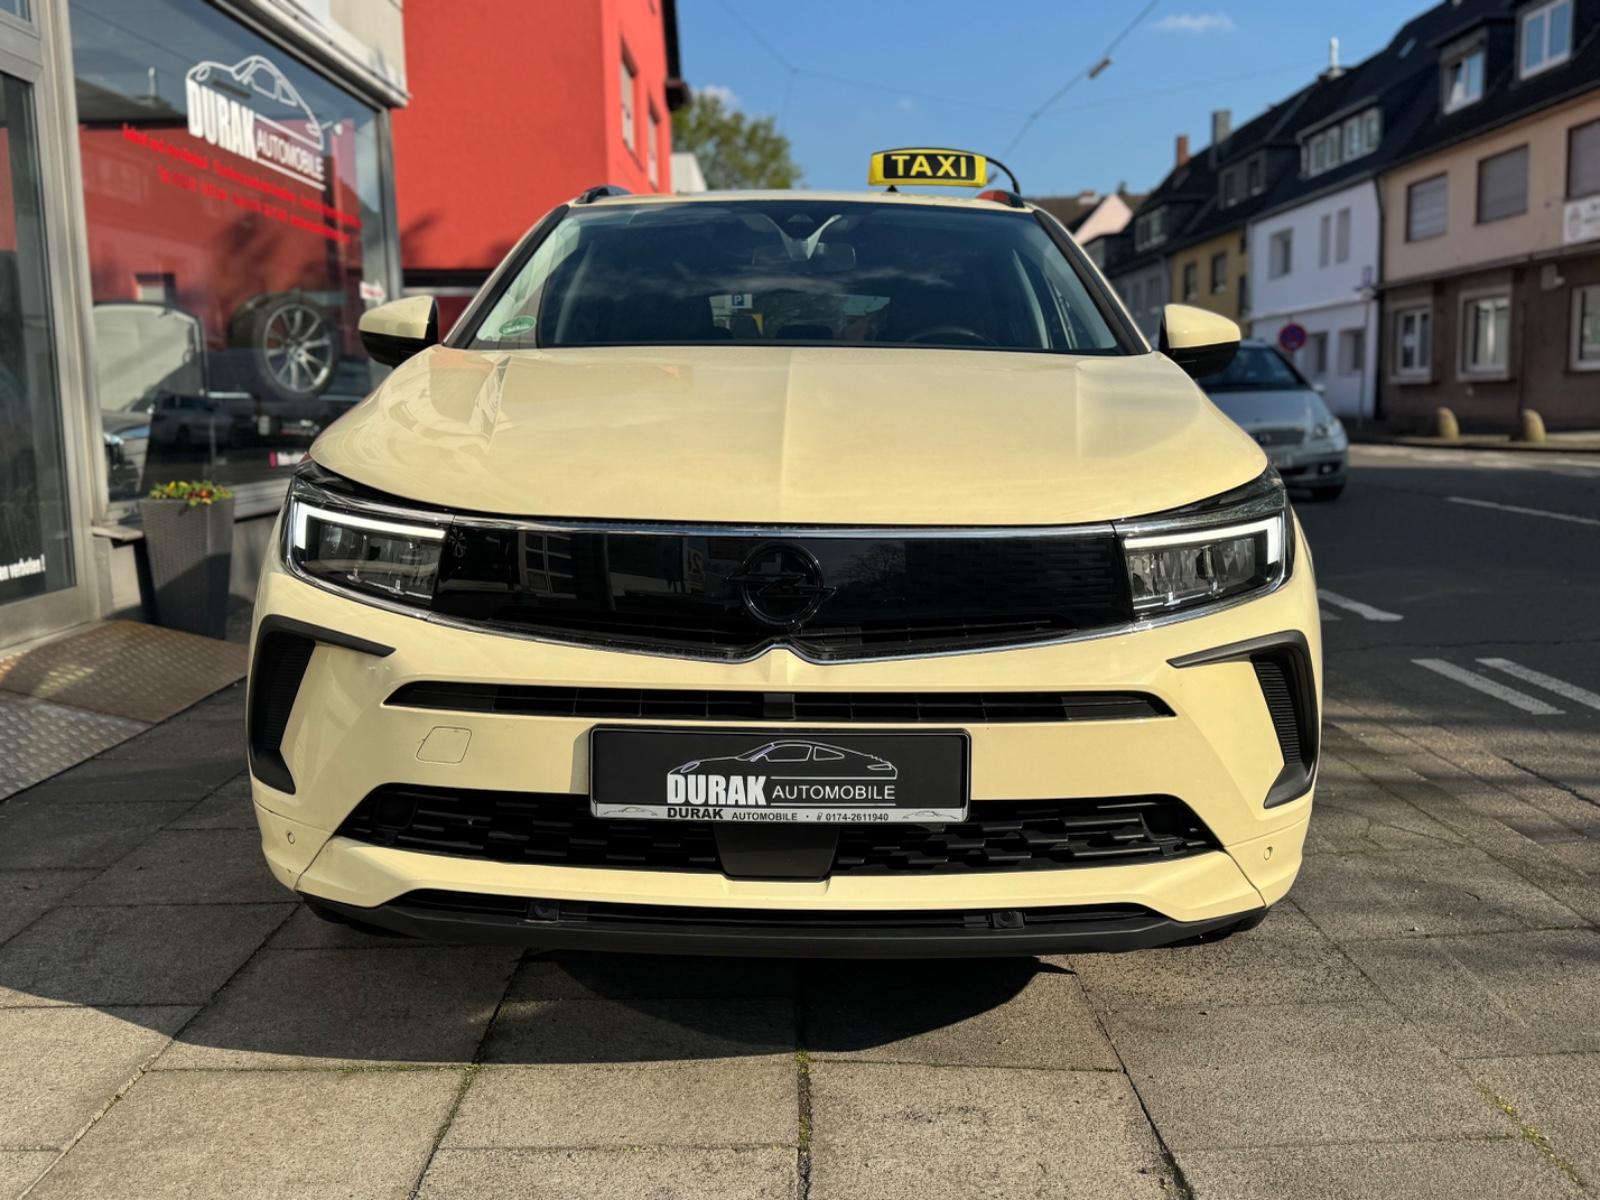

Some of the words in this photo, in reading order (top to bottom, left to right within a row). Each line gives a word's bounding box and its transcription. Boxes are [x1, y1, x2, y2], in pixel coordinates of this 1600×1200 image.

[186, 77, 258, 162] DURAK
[256, 128, 325, 181] AUTOMOBILE
[890, 155, 967, 178] TAXI
[667, 773, 768, 806] DURAK
[772, 784, 896, 801] AUTOMOBILE
[667, 807, 724, 821] DURAK
[731, 811, 798, 822] AUTOMOBILE
[825, 812, 889, 823] 0174-2611940
